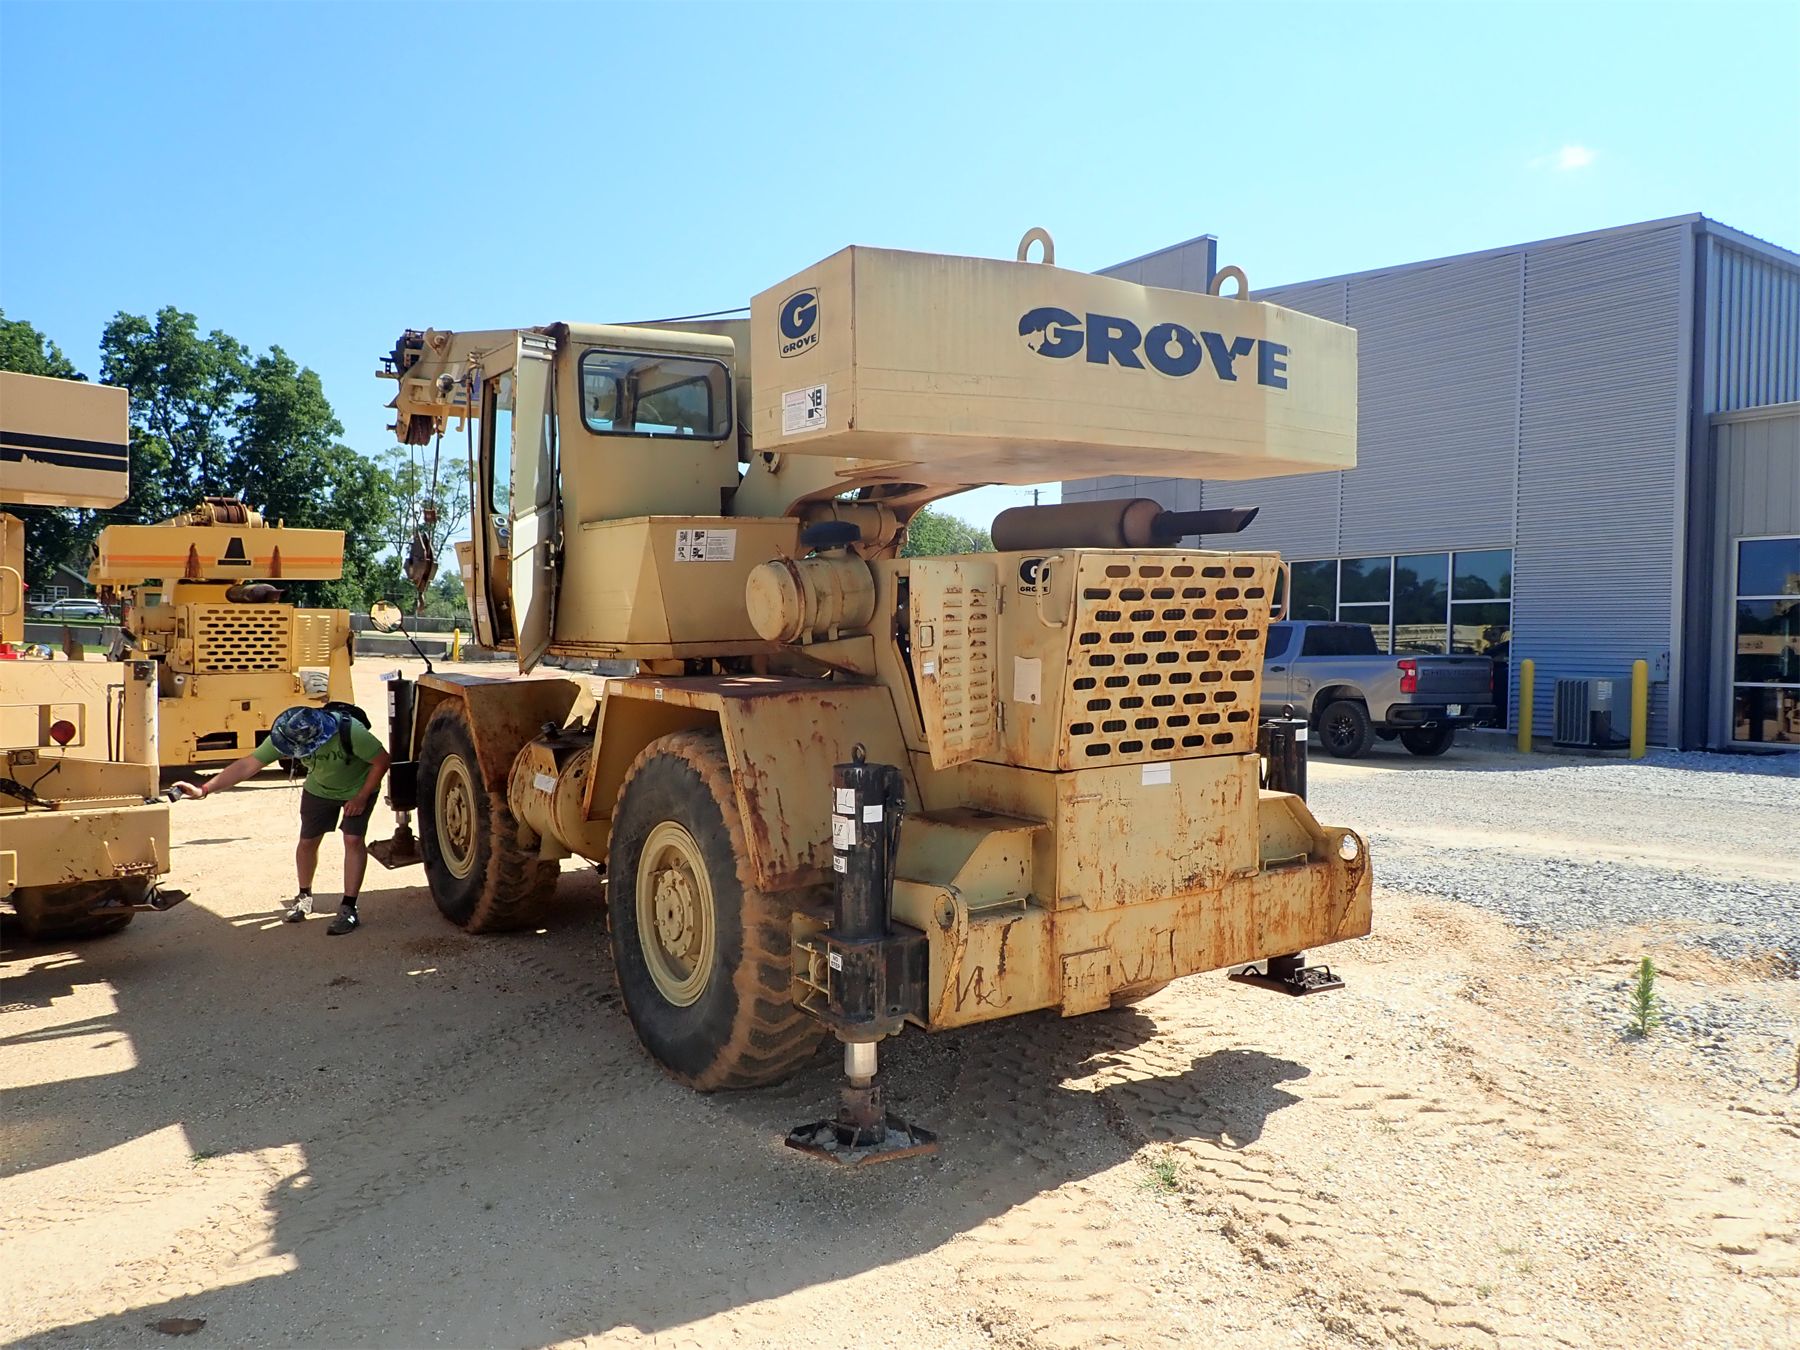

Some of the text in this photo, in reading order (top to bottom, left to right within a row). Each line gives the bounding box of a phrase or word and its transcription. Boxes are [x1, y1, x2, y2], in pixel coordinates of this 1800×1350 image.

[780, 293, 817, 339] G
[783, 333, 817, 354] GROVE
[1018, 306, 1288, 390] GROVE
